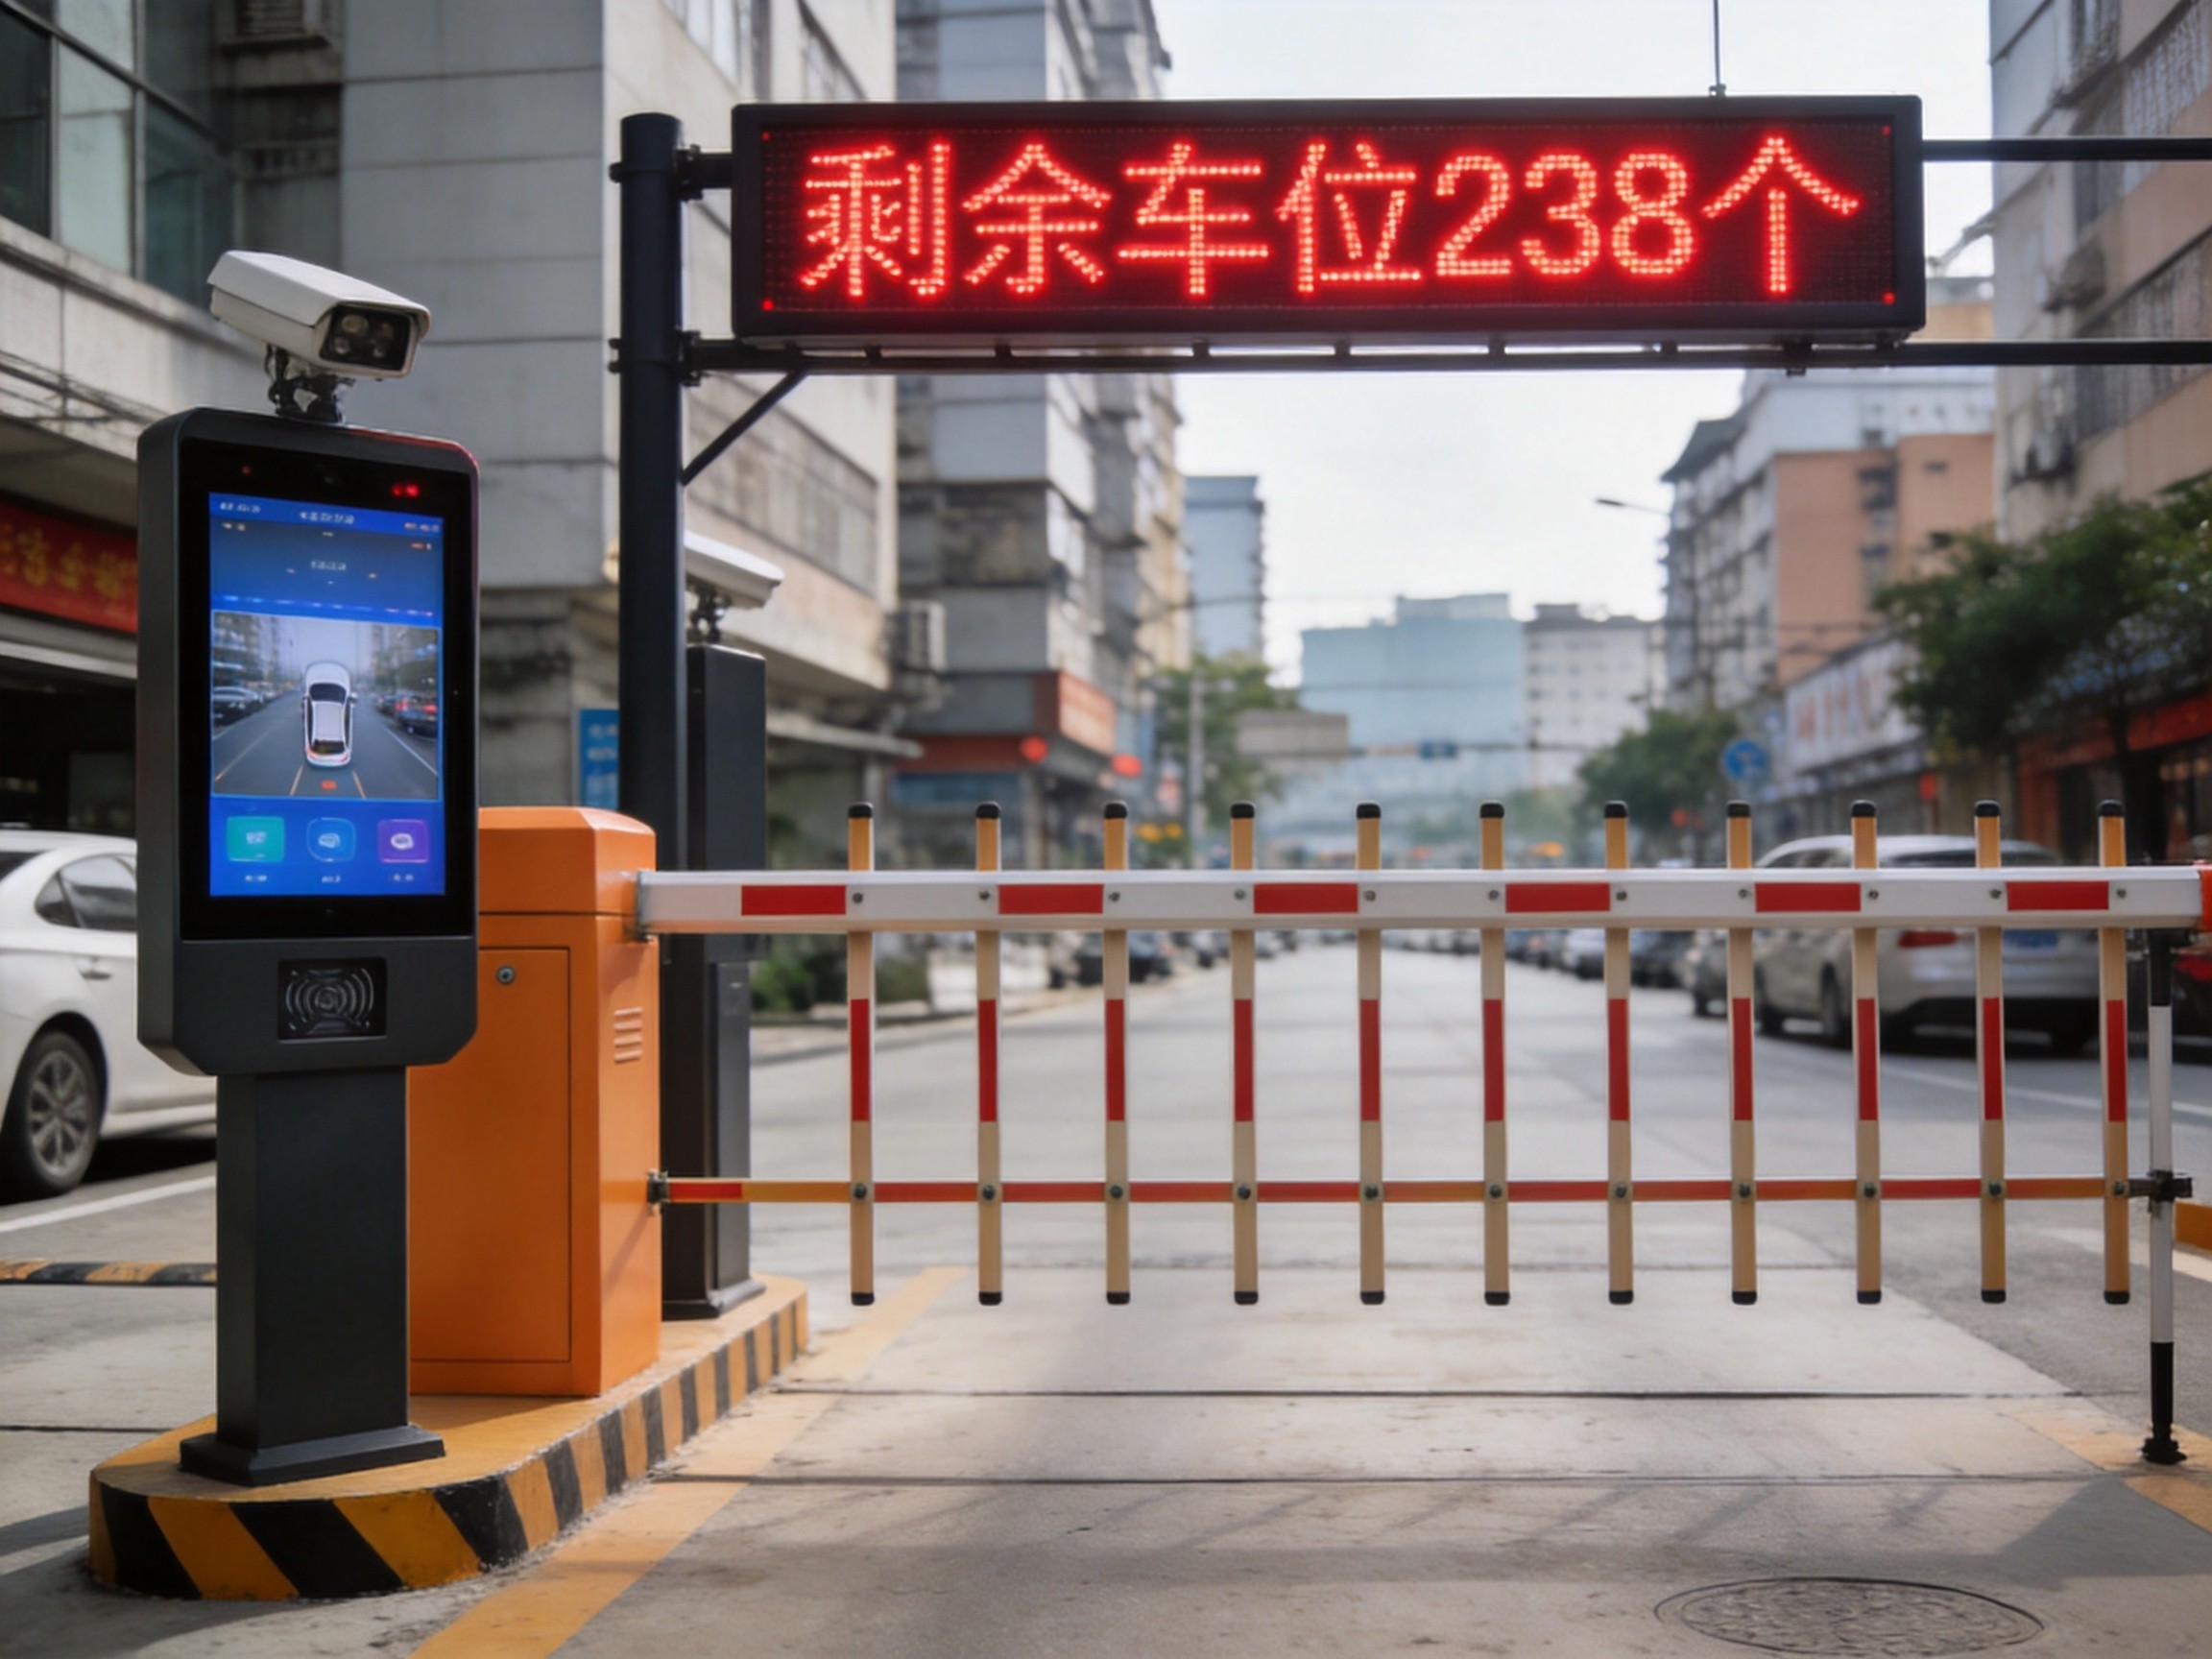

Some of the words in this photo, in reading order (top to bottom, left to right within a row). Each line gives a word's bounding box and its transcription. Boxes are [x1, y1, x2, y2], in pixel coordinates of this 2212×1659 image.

[800, 138, 1861, 297] 剩余车位238个
